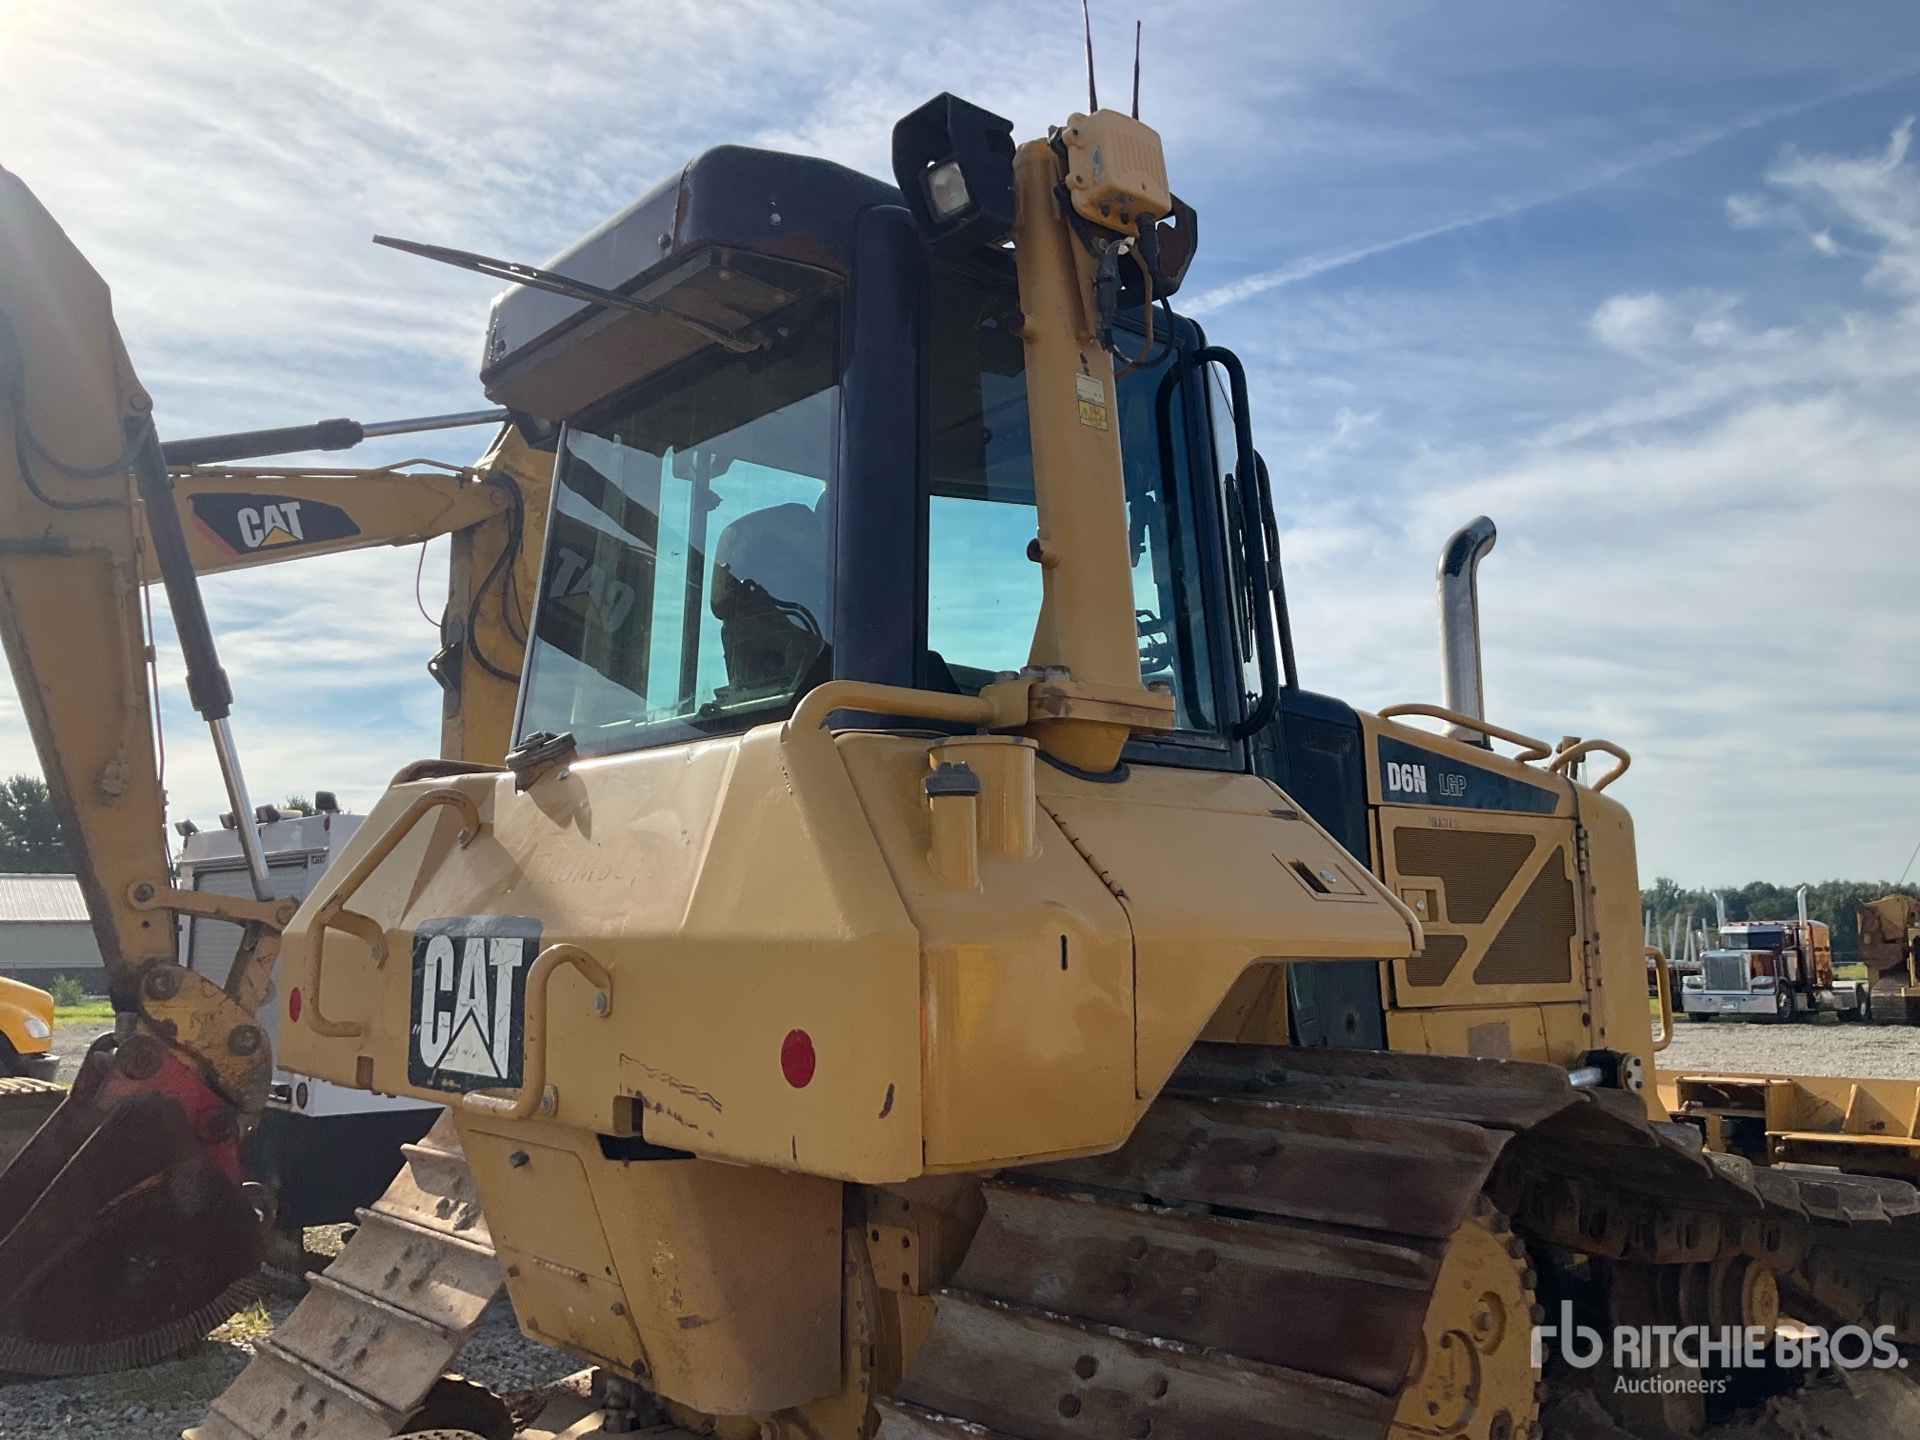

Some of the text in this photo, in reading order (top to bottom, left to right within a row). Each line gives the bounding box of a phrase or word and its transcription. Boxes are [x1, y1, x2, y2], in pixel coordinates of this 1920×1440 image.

[237, 501, 303, 548] CAT
[1387, 762, 1466, 796] D6N LGP
[420, 934, 523, 1079] CAT
